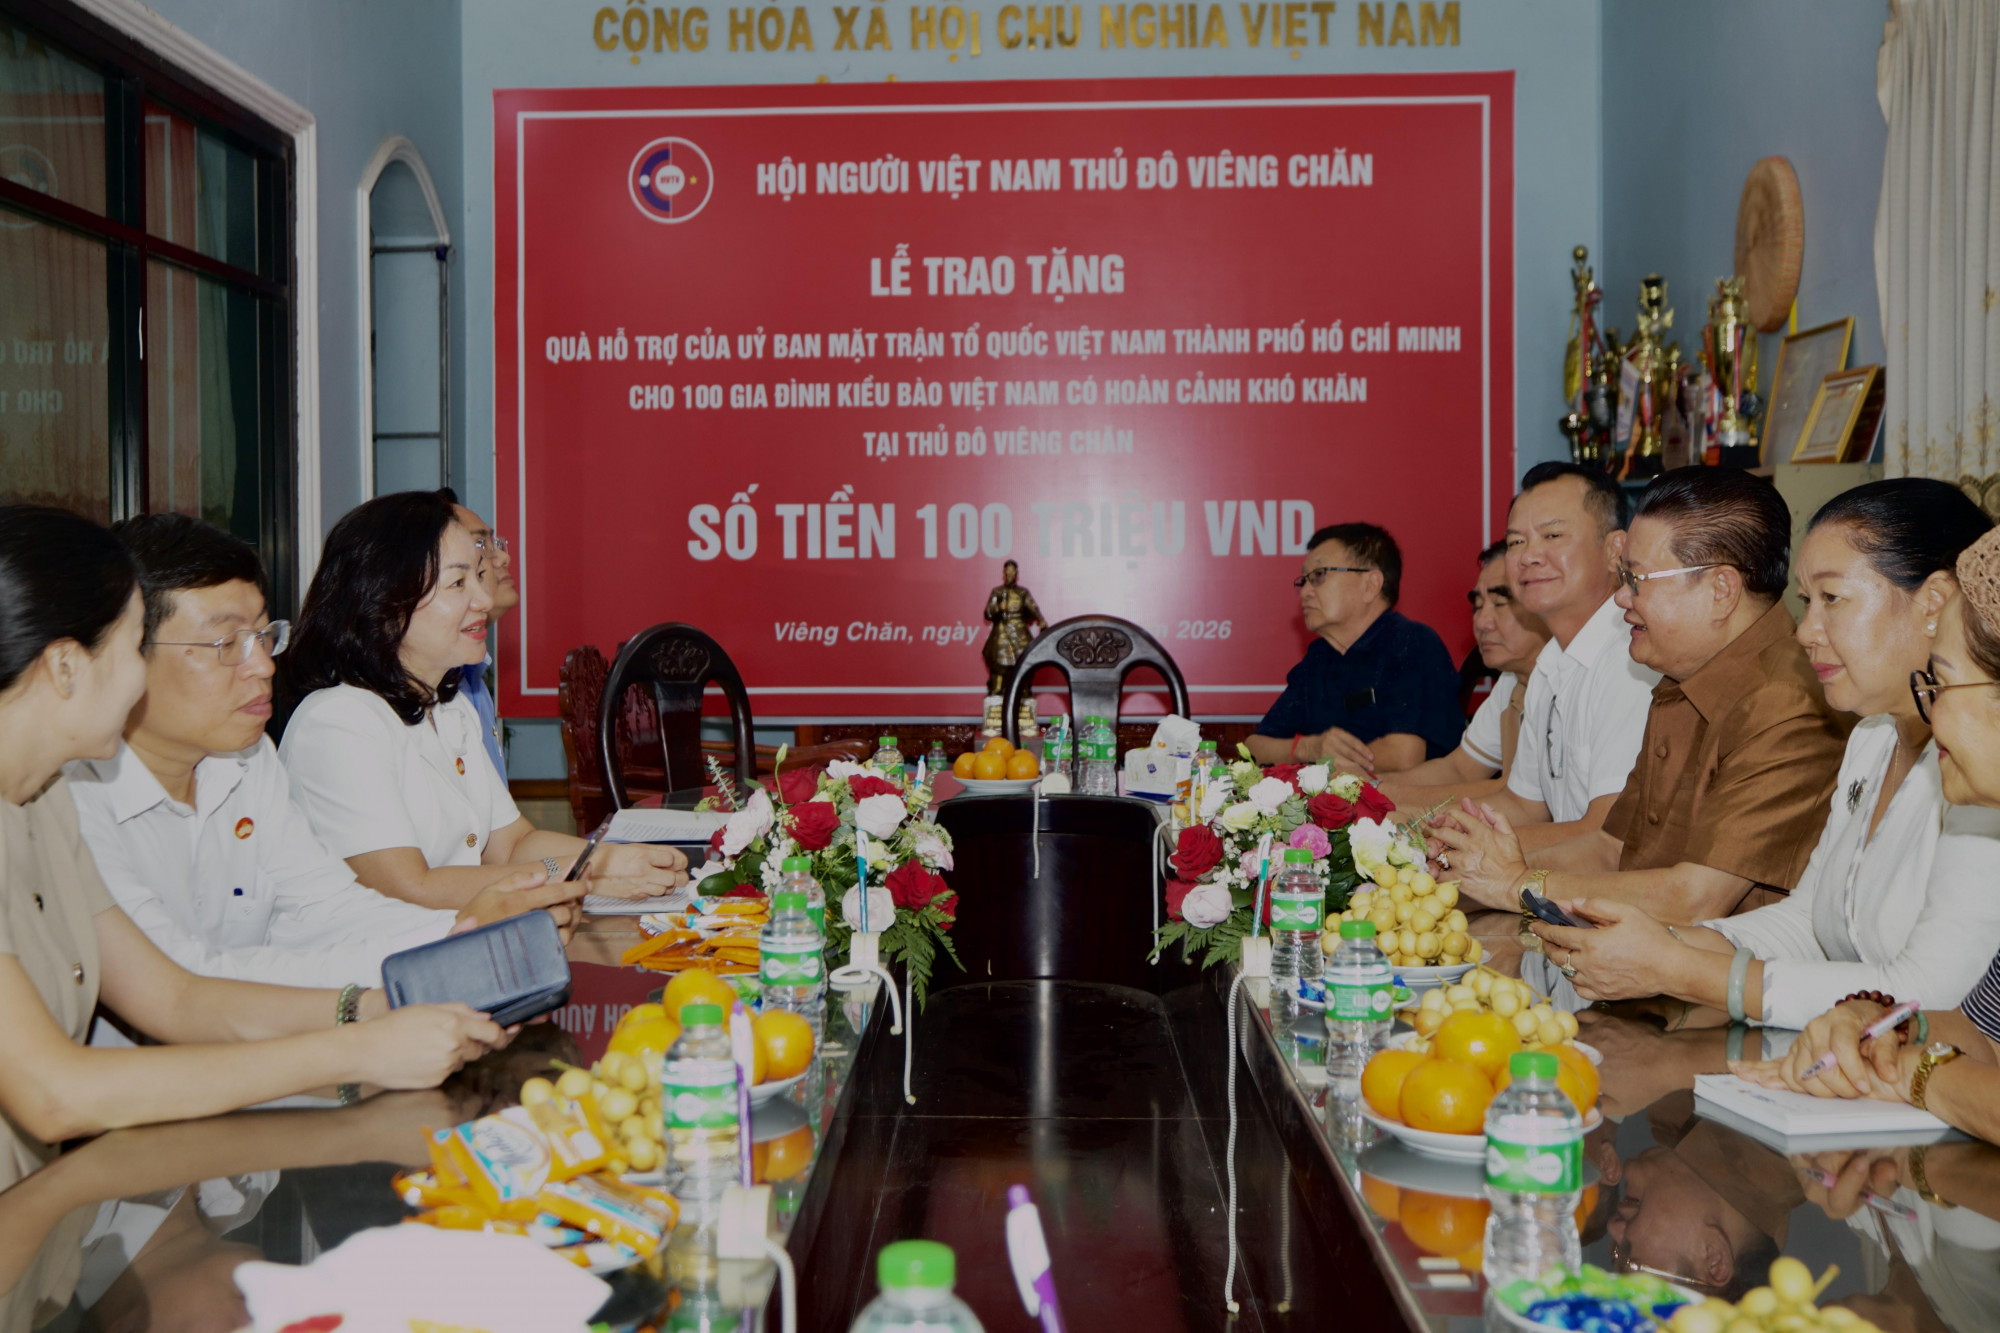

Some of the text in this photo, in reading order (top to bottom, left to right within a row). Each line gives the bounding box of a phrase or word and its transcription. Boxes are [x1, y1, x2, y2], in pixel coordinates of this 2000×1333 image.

[1358, 1, 1460, 47] NAM
[757, 147, 1373, 202] HỘI NGƯỜI VIỆT NAM THỦ ĐÔ VIÊNG CHĂN
[870, 243, 1125, 303] LỄ TRAO TẶNG
[545, 319, 1461, 365] QUÀ HỖ TRỢ CỦA UỶ BAN MẶT TRẬN TỔ QUỐC VIỆT NAM THÀNH PHỐ HỒ CHÍ MINH
[629, 371, 1367, 412] CHO 100 GIA ĐÌNH KIỀU BÀO VIỆT NAM CÓ HOÀN CẢNH KHÓ KHĂN
[863, 423, 1134, 462] TẠI THỦ ĐÔ VIÊNG CHĂN
[687, 483, 1316, 570] SỐ TIỀN 100 TRIỆU VND
[774, 621, 839, 646] Viêng
[847, 619, 913, 644] Chăn,
[921, 621, 980, 647] ngày
[1176, 619, 1233, 640] 2026
